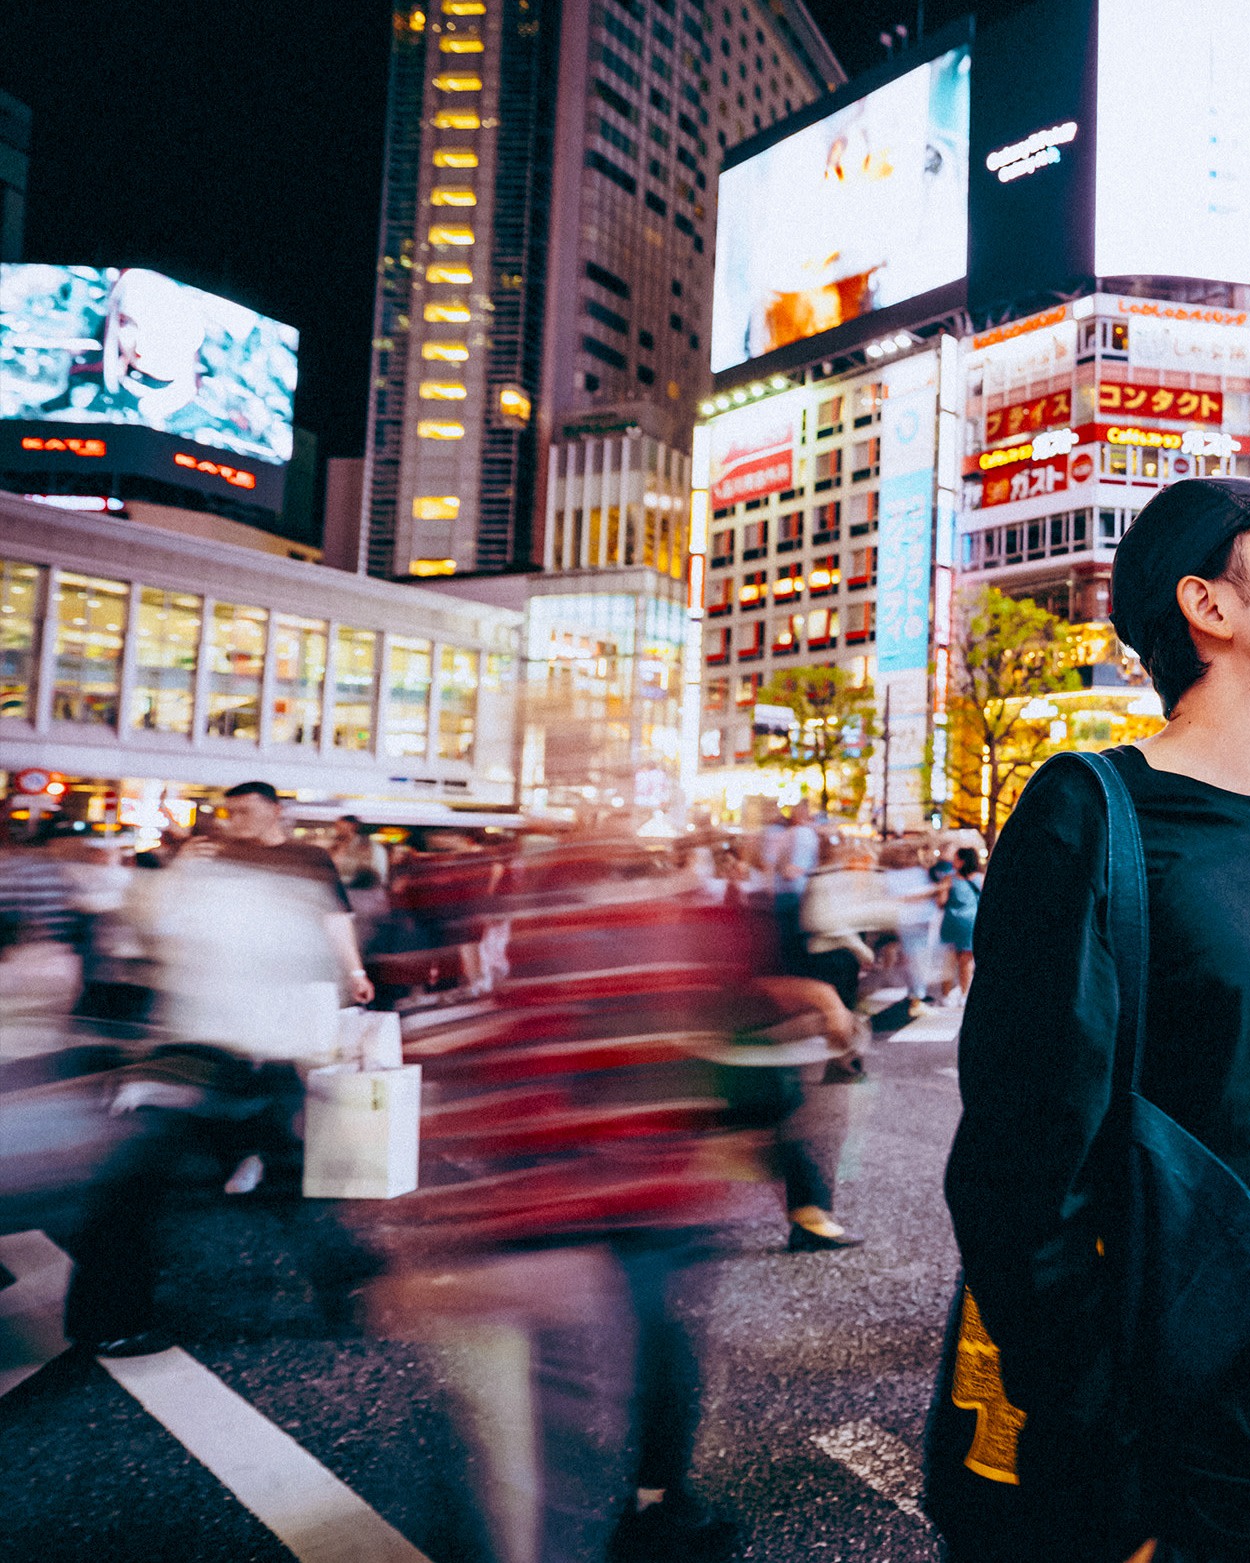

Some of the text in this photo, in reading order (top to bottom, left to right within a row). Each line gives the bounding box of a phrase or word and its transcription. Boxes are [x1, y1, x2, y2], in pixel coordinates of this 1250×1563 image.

[1099, 384, 1219, 417] コンタクト
[1010, 464, 1066, 501] ガスト
